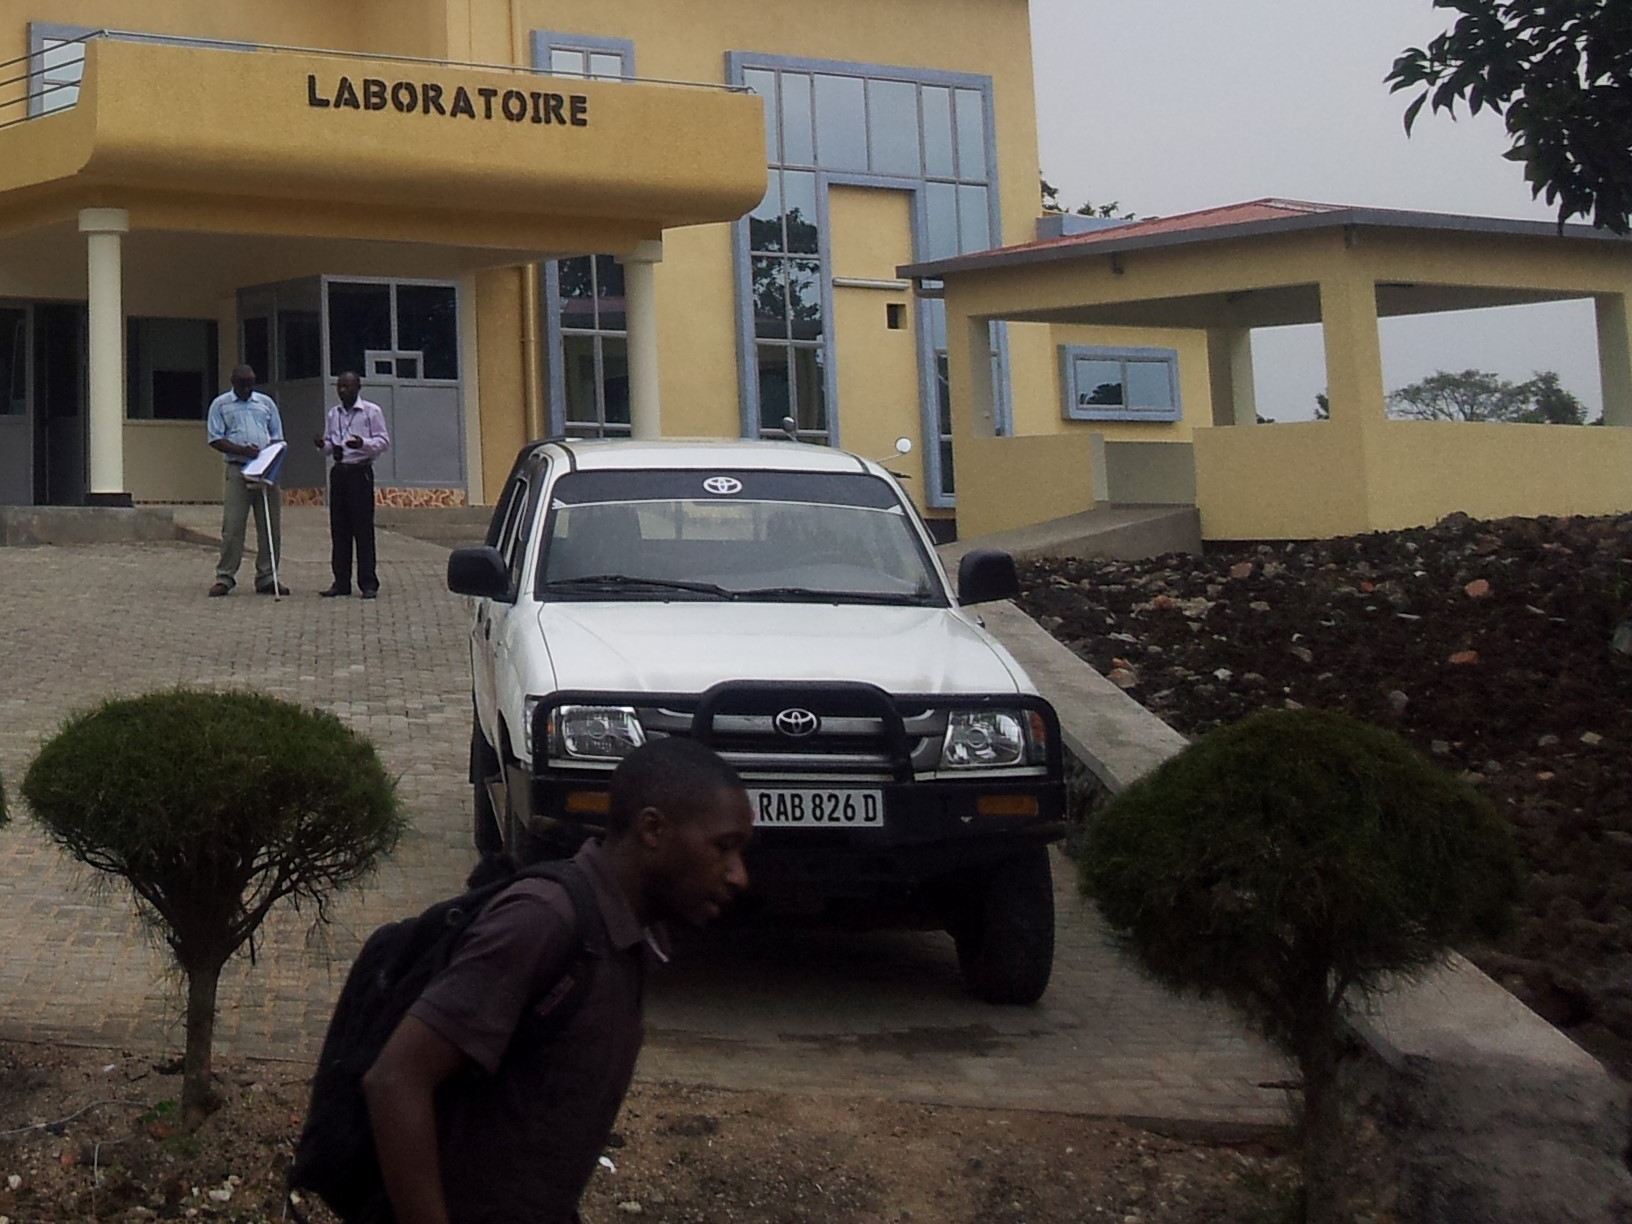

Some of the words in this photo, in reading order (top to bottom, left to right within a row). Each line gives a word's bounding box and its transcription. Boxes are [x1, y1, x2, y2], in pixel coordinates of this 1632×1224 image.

[307, 74, 588, 126] LABORATOIRE
[758, 792, 805, 822] RAB
[811, 793, 856, 822] 826
[862, 794, 877, 822] D
